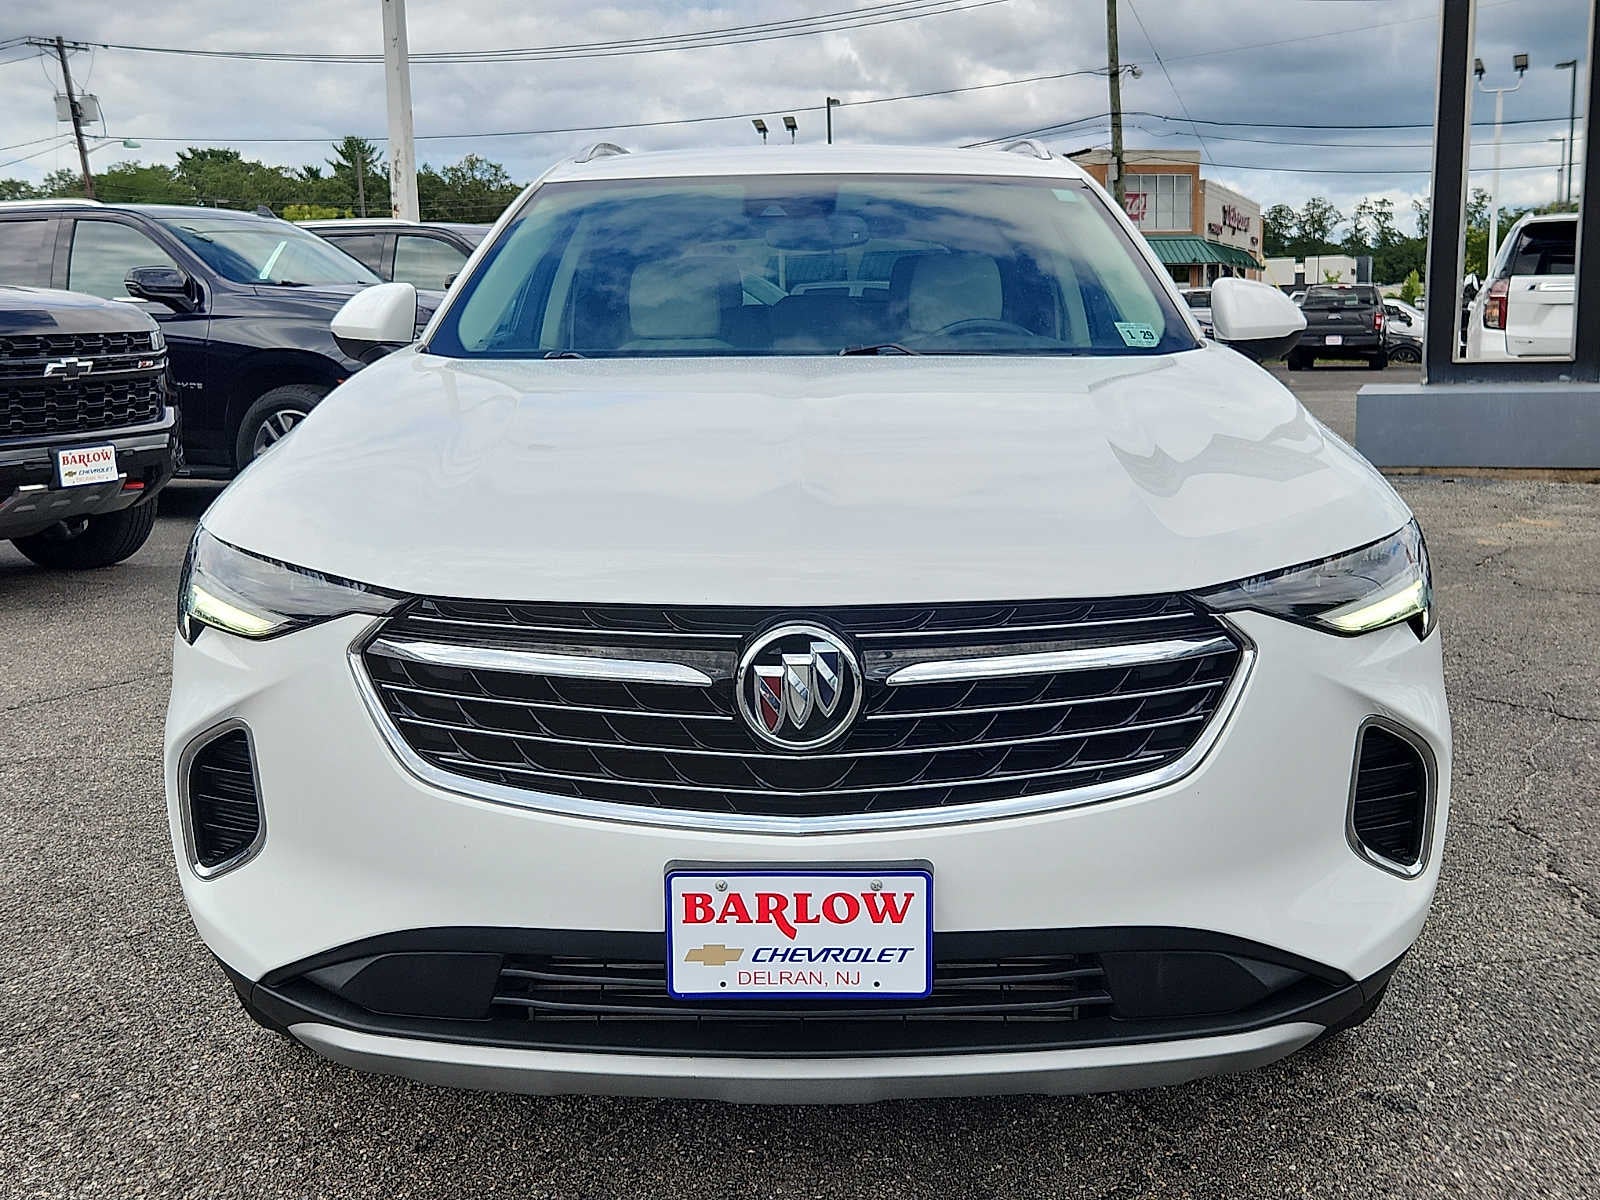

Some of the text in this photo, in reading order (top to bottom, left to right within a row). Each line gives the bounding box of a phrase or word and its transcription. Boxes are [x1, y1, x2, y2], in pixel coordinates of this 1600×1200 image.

[1140, 330, 1155, 340] 29
[62, 449, 112, 467] BARLOW
[681, 892, 915, 940] BARLOW
[751, 947, 915, 963] CHEVROLET
[737, 971, 861, 988] DELRAN, NJ
